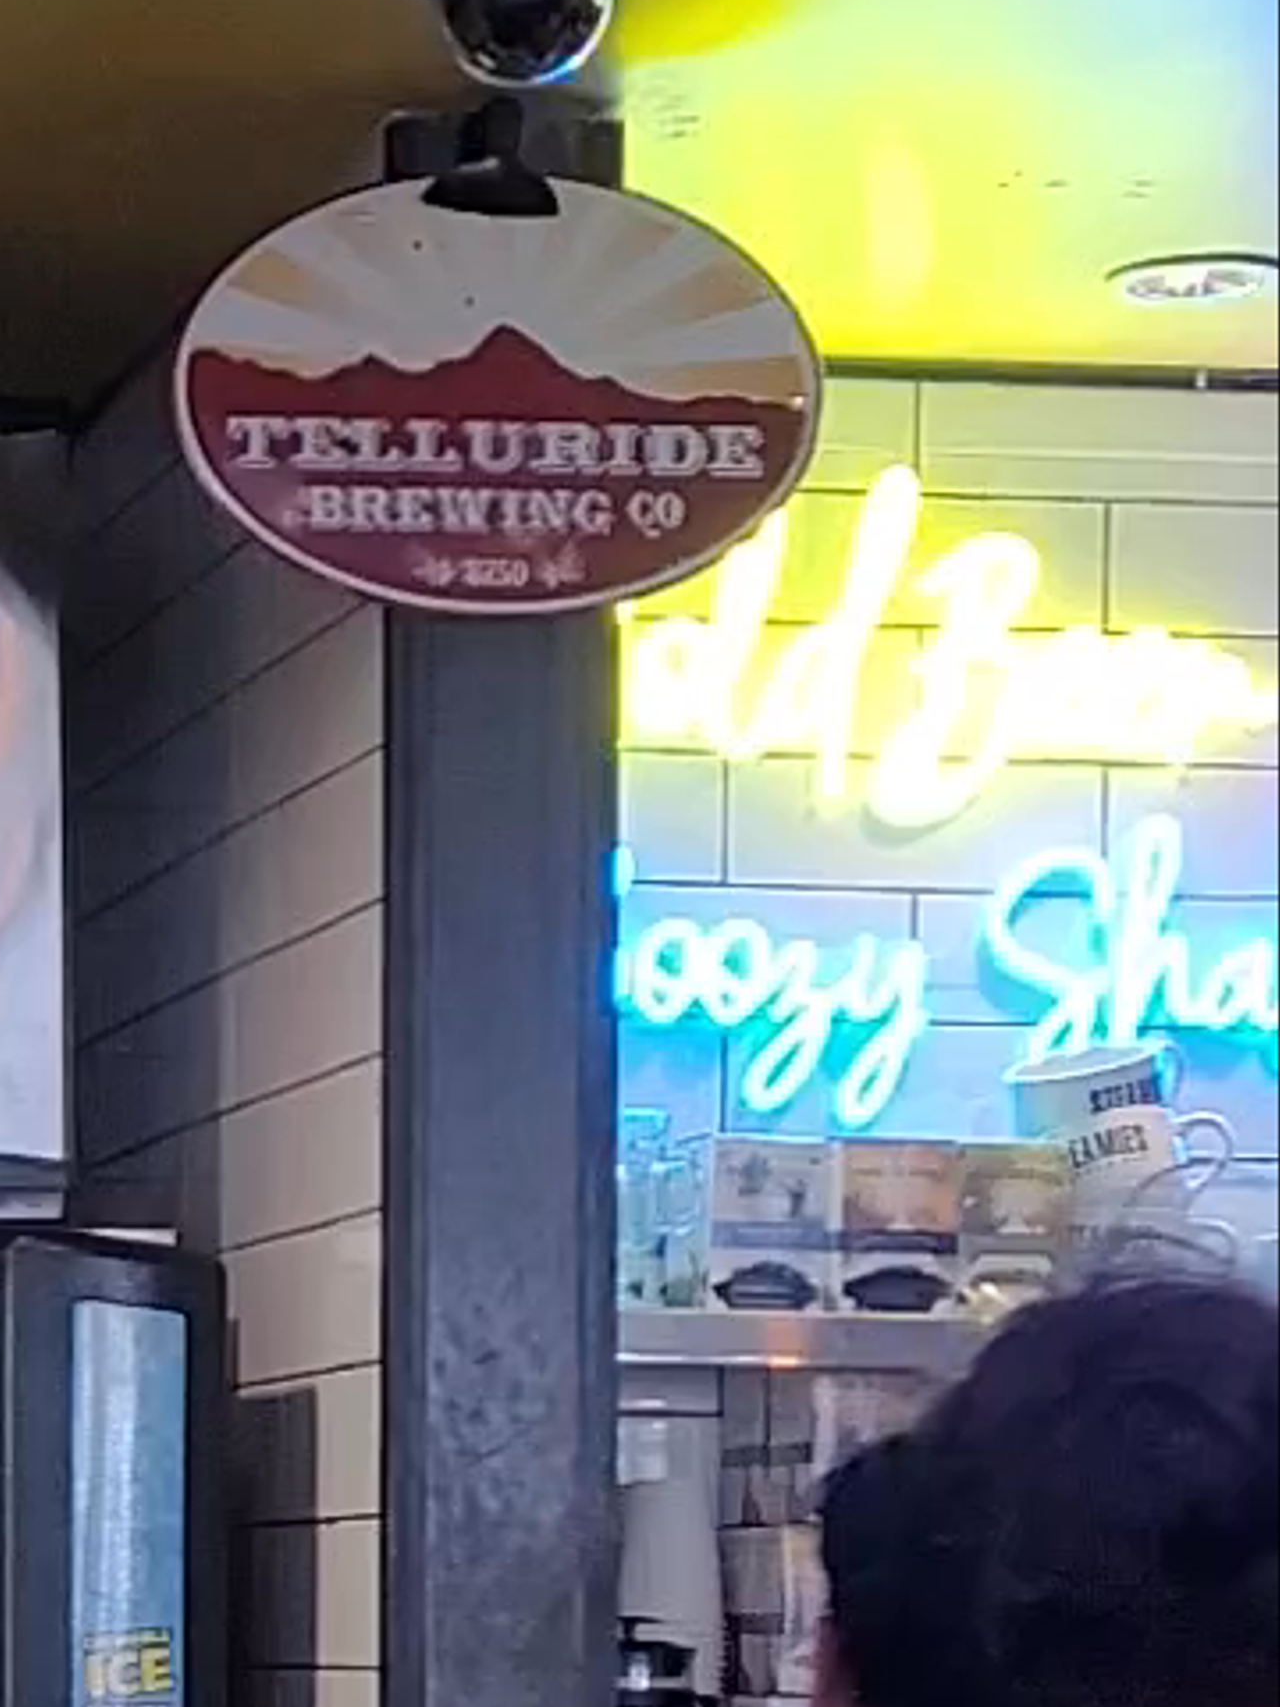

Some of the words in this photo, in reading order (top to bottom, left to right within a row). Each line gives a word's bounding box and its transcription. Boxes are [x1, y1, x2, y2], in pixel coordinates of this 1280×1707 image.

[226, 414, 765, 479] TELLURIDE
[304, 484, 613, 536] BREWING
[626, 489, 686, 538] CO
[83, 1645, 174, 1699] ICE
